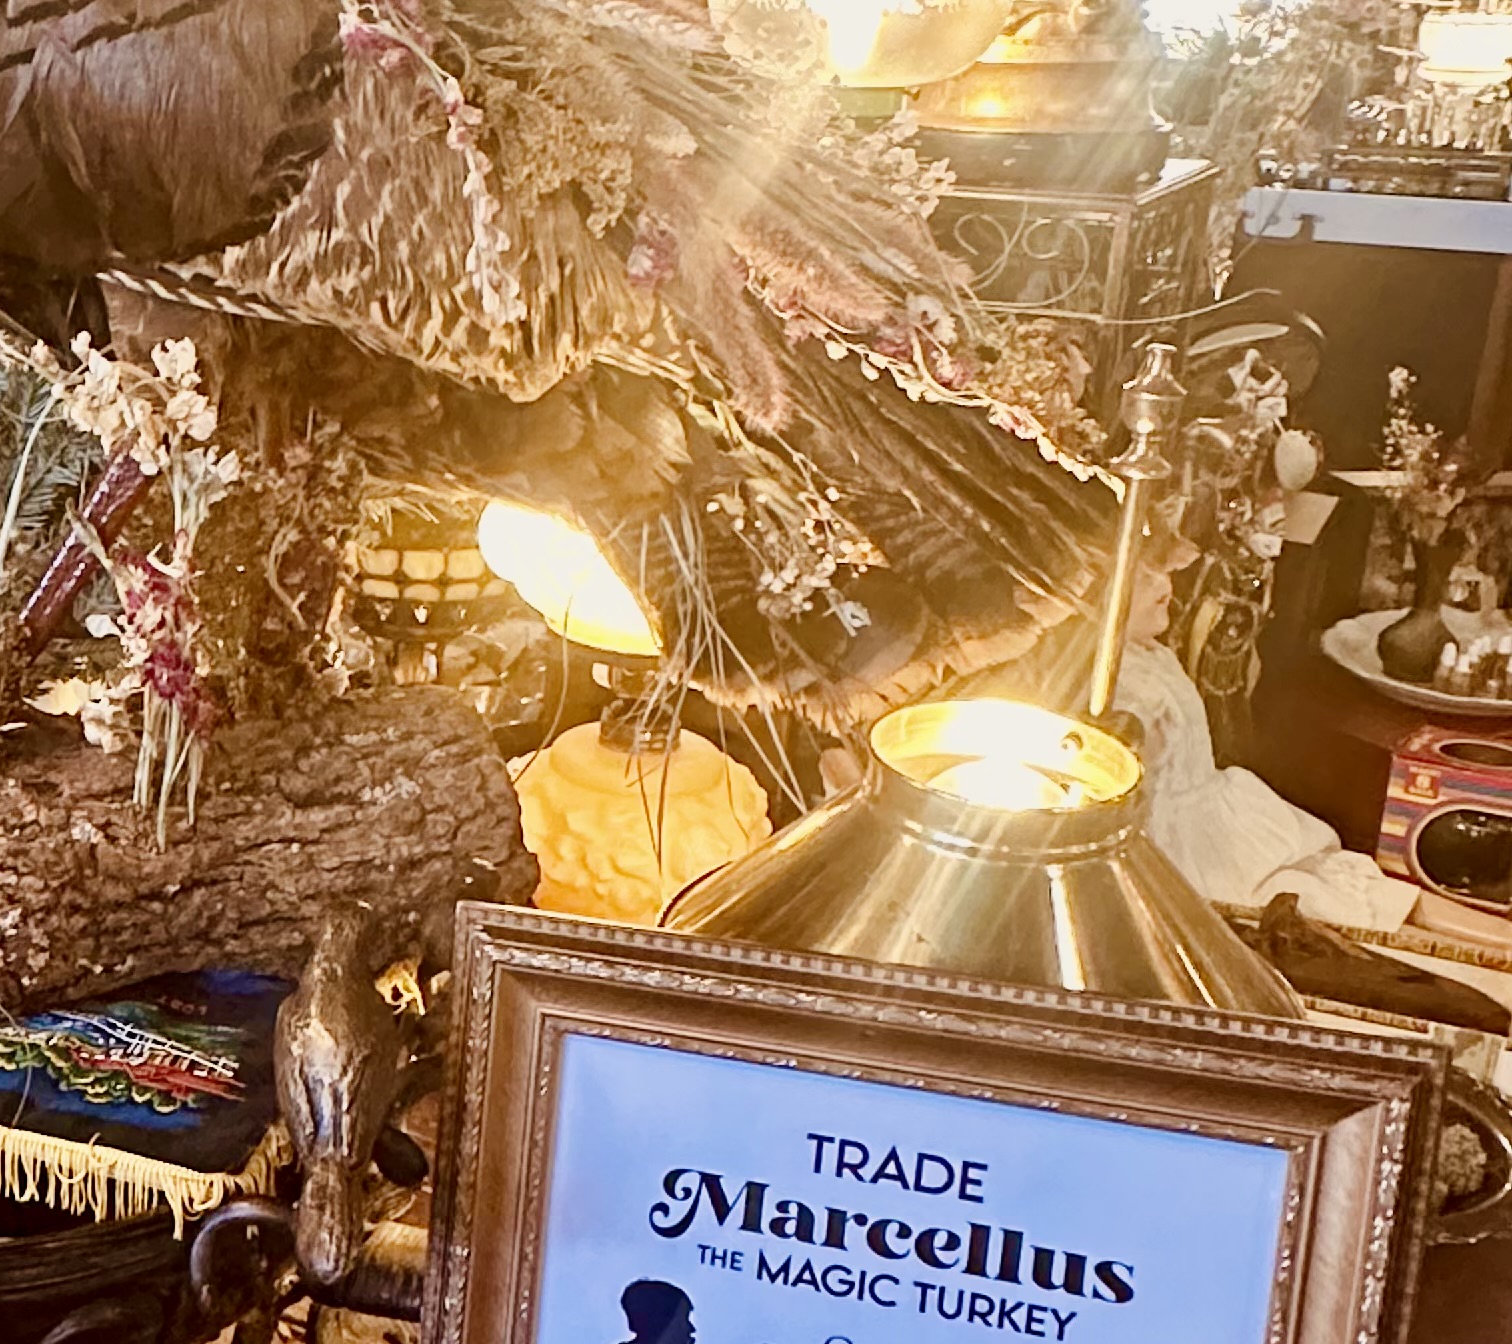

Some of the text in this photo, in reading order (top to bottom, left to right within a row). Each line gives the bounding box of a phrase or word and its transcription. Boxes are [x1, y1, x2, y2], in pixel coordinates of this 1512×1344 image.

[806, 1132, 989, 1204] TRADE
[648, 1167, 1136, 1304] Marcellus
[696, 1243, 1078, 1342] THE MAGIC TURKEY
